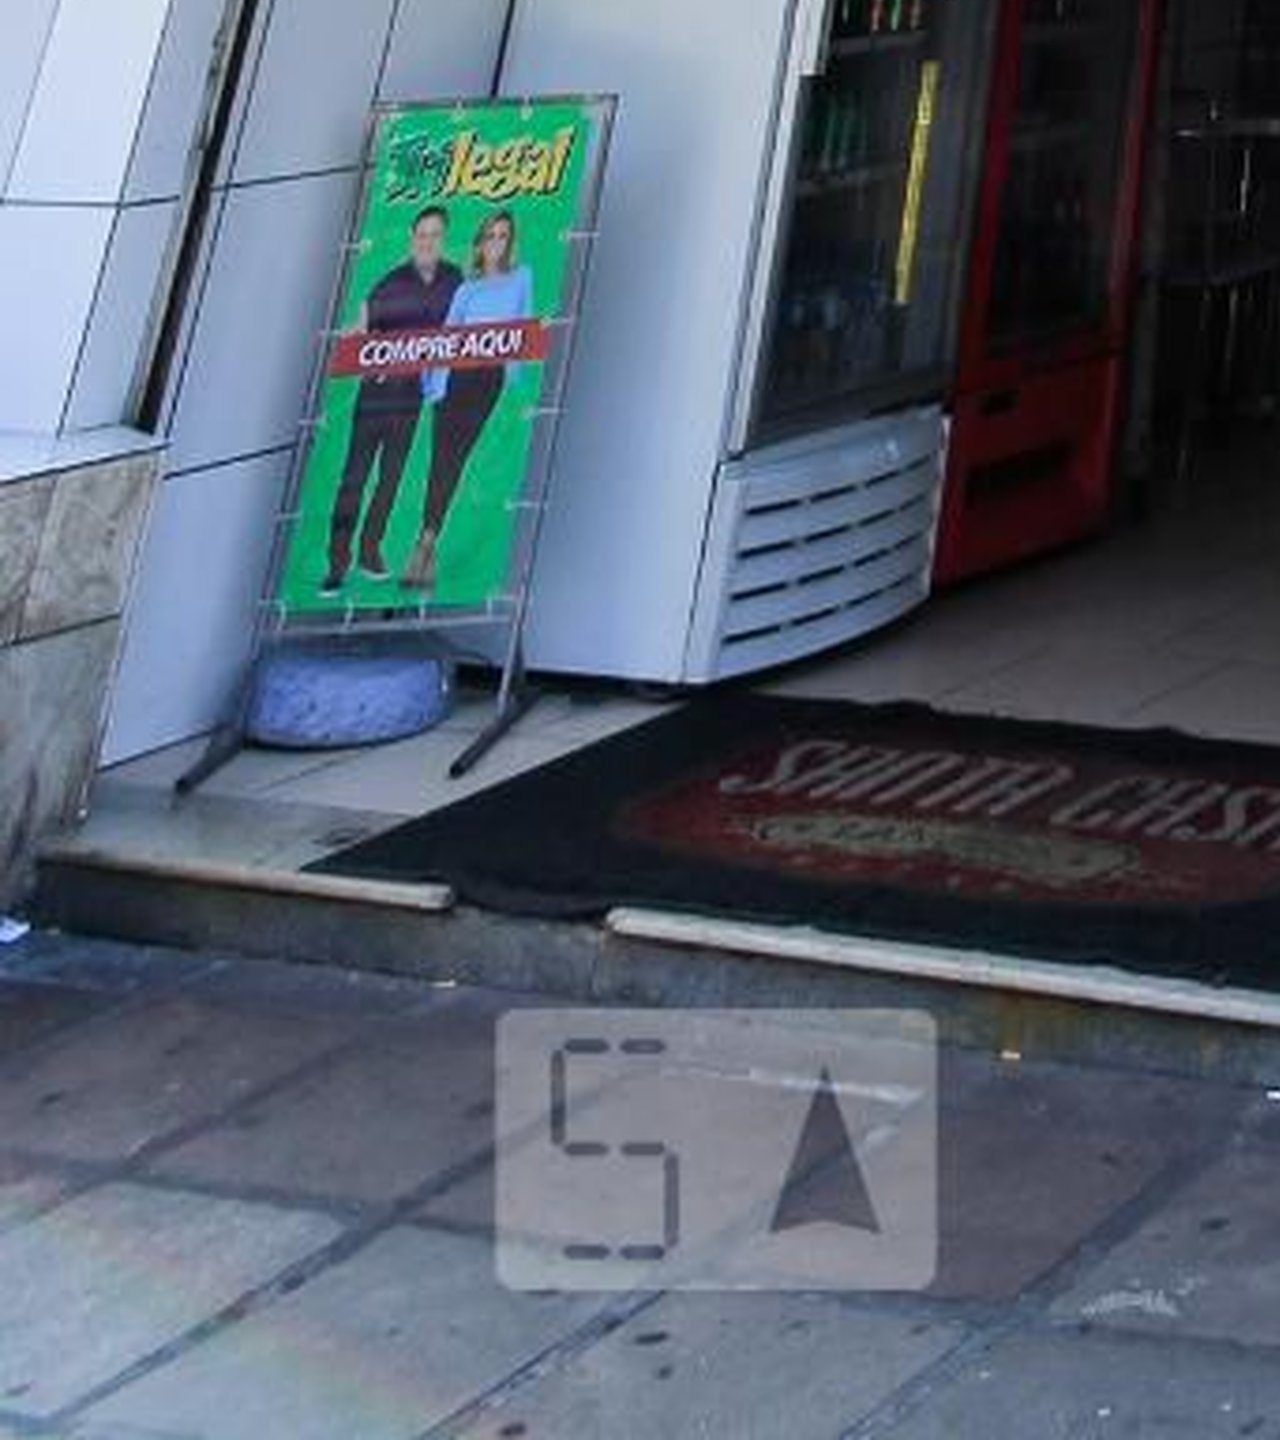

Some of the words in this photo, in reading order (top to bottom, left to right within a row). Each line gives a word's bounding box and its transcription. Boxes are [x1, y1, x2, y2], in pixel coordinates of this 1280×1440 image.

[359, 337, 458, 366] COMPRE
[461, 329, 523, 358] AQUI
[718, 739, 1077, 816] SANTA
